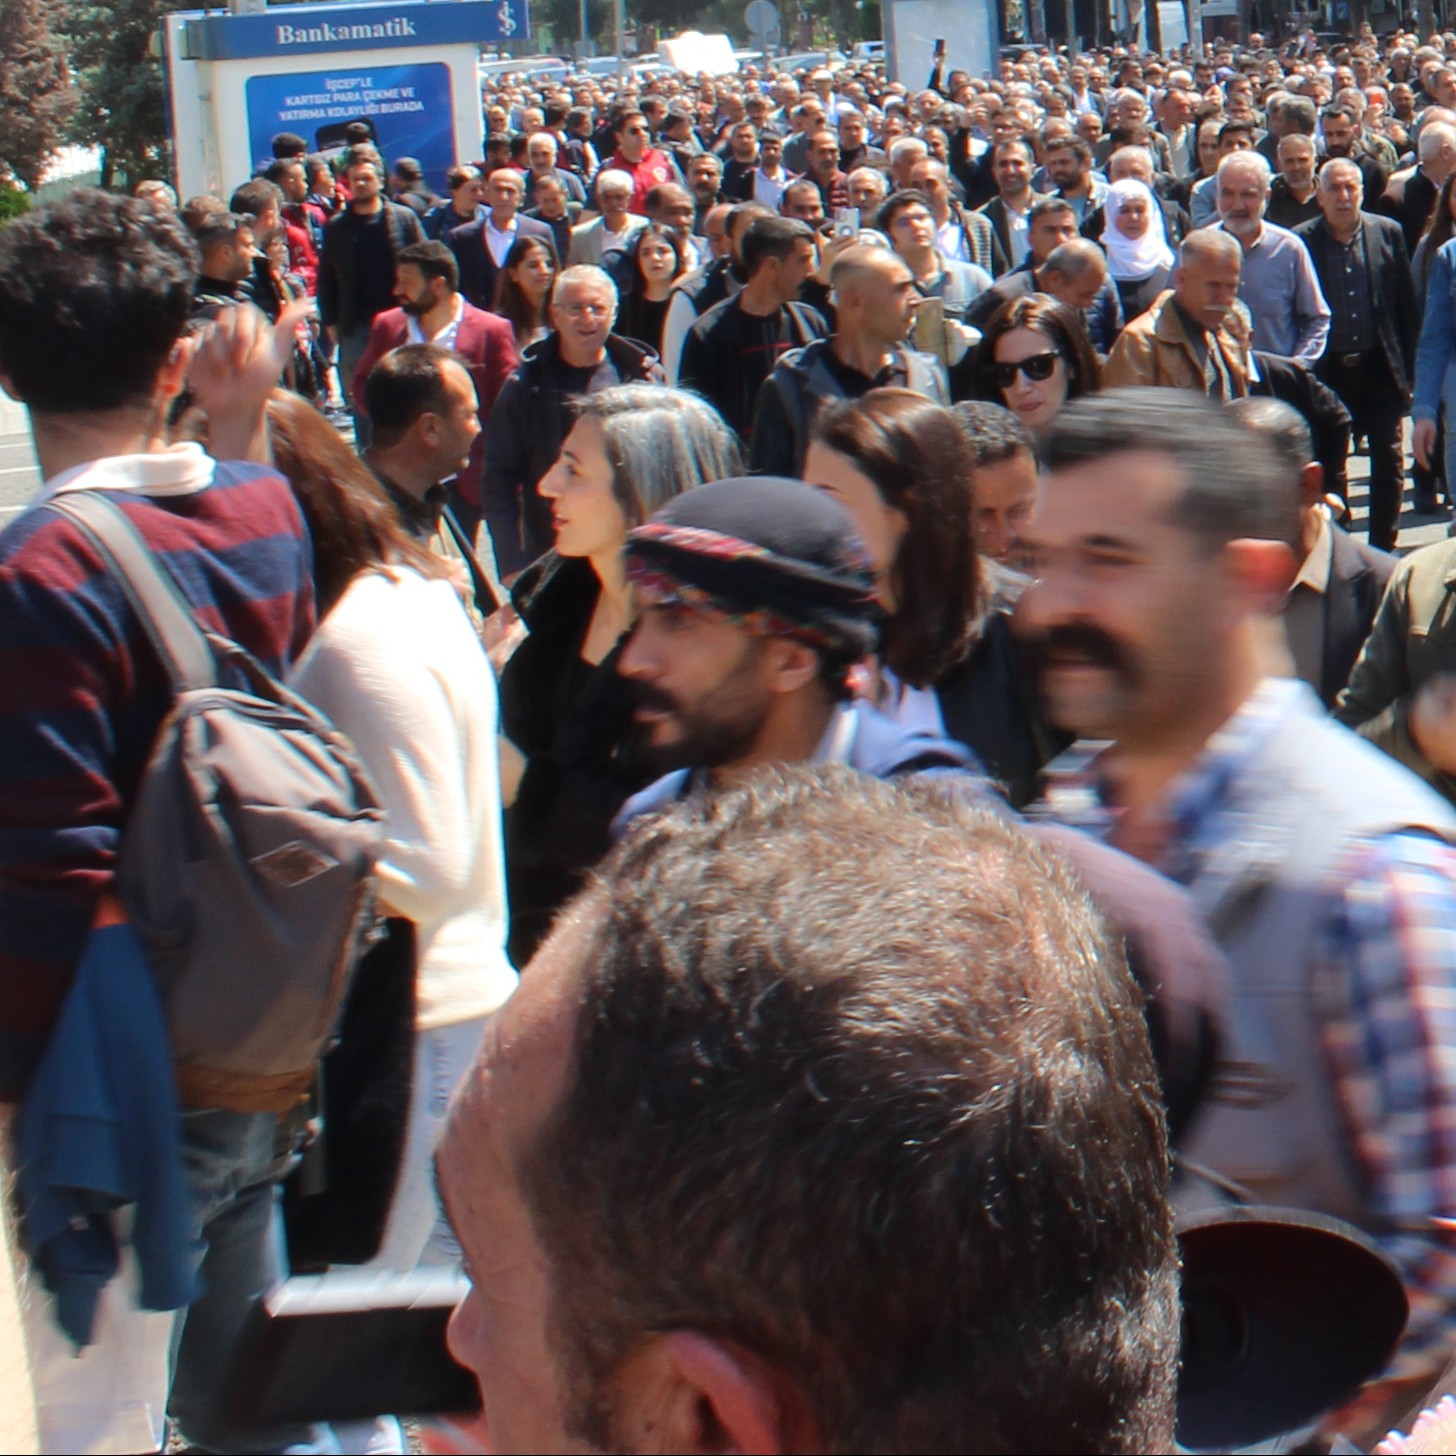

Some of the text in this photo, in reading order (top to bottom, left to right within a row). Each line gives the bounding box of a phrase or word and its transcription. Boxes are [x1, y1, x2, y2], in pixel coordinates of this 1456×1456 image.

[277, 17, 417, 45] Bankamatik
[285, 87, 415, 107] KARTSIZ PARA ÇEKME VE
[278, 101, 424, 121] YATIRMA KOLAYLIĞI BURADA
